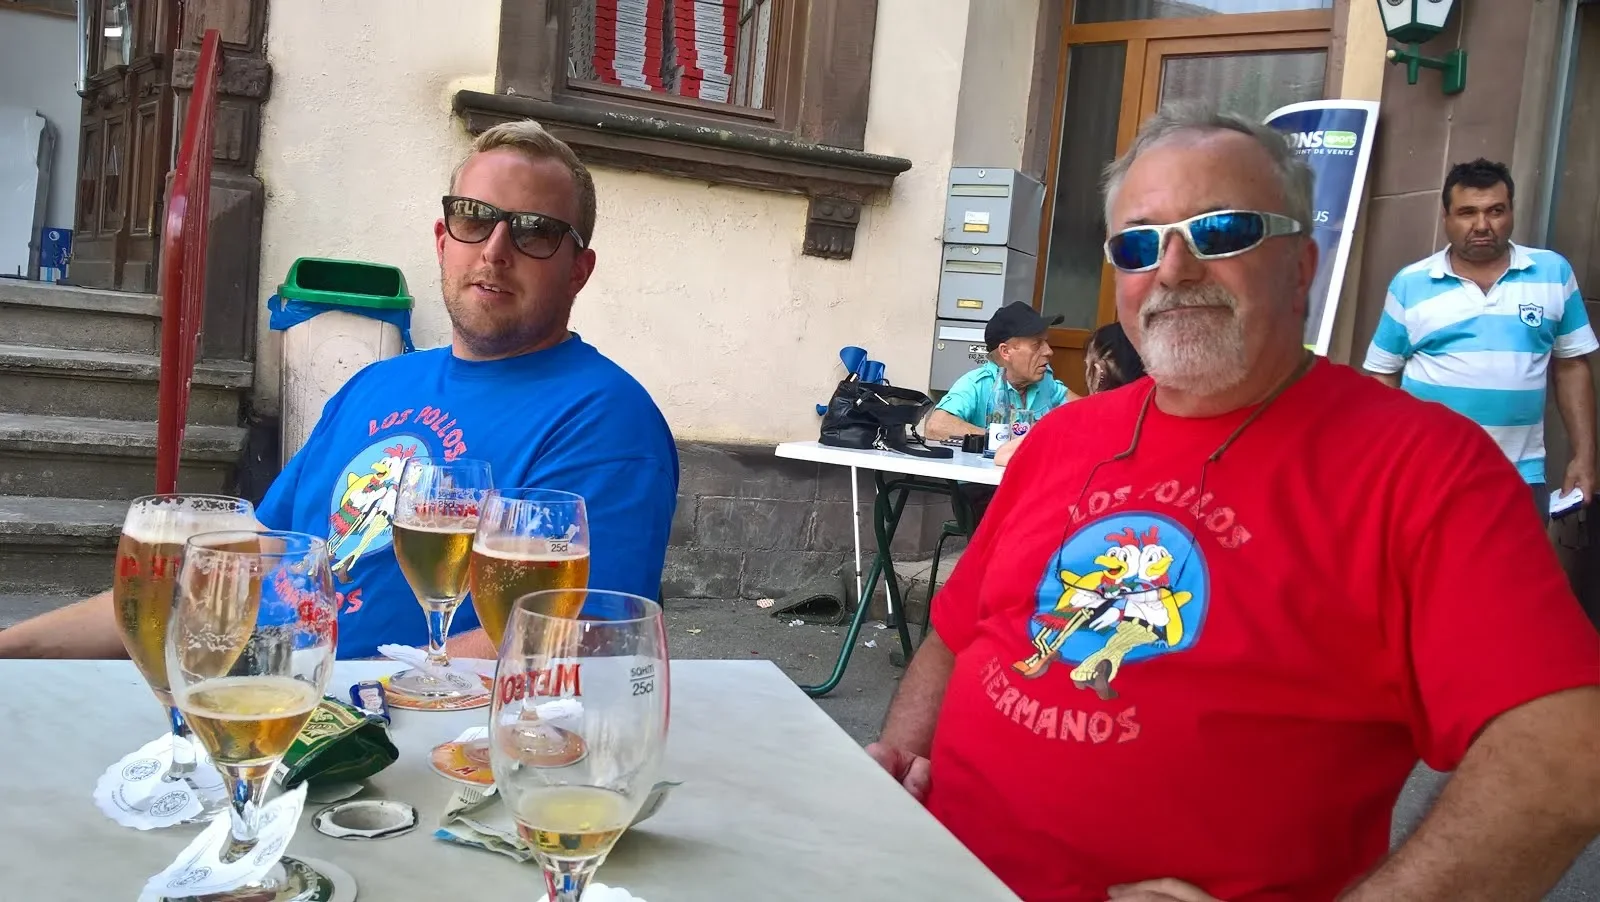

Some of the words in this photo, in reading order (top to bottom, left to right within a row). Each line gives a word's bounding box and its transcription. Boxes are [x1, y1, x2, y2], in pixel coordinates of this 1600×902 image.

[368, 408, 415, 437] LOS
[413, 405, 467, 463] POLLOS
[1068, 485, 1132, 524] LOS
[551, 543, 568, 552] 25cl
[632, 679, 654, 696] 25cl
[981, 656, 1141, 744] HERMANOS
